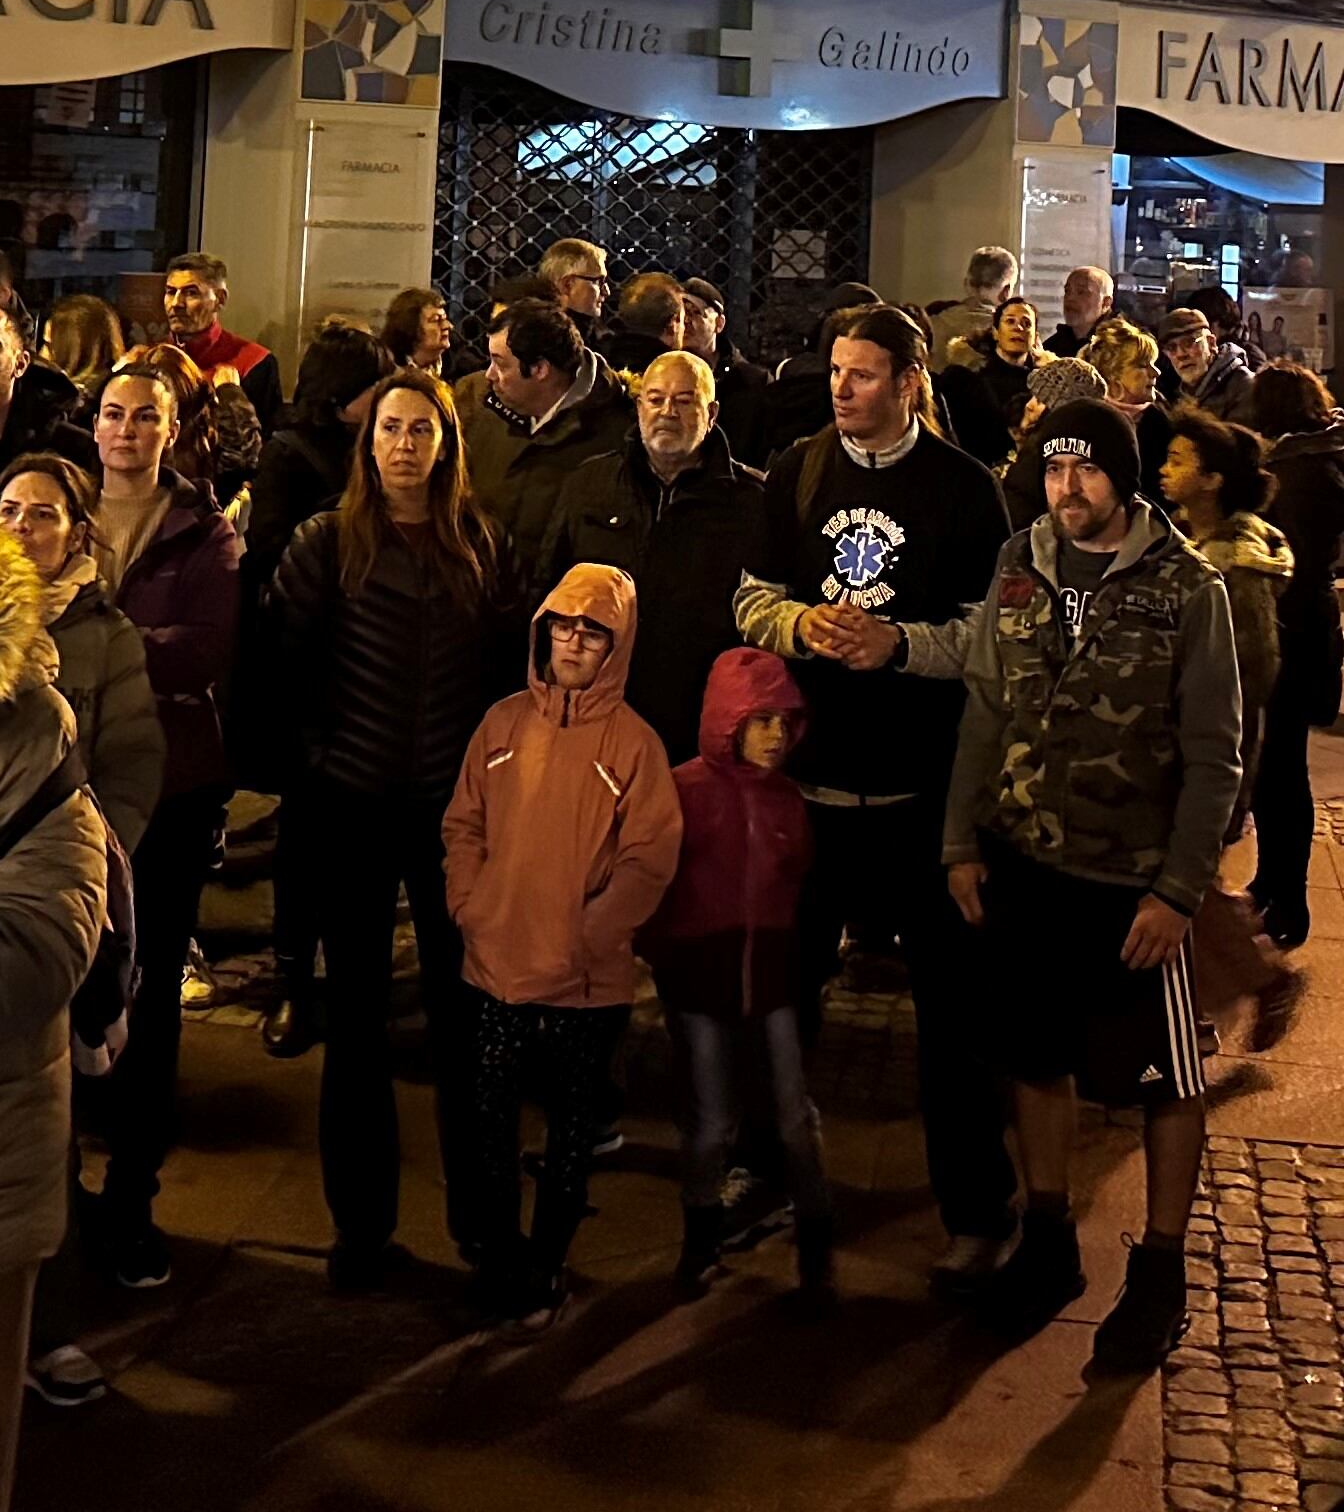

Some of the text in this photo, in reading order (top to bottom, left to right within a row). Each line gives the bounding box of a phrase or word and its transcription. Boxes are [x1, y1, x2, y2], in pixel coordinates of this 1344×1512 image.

[817, 25, 971, 77] Galindo
[340, 160, 401, 174] FARMACIA
[1042, 437, 1092, 459] SEPULTURA
[821, 509, 850, 539] TES
[850, 507, 867, 524] DE
[821, 573, 896, 609] EN LUCHA
